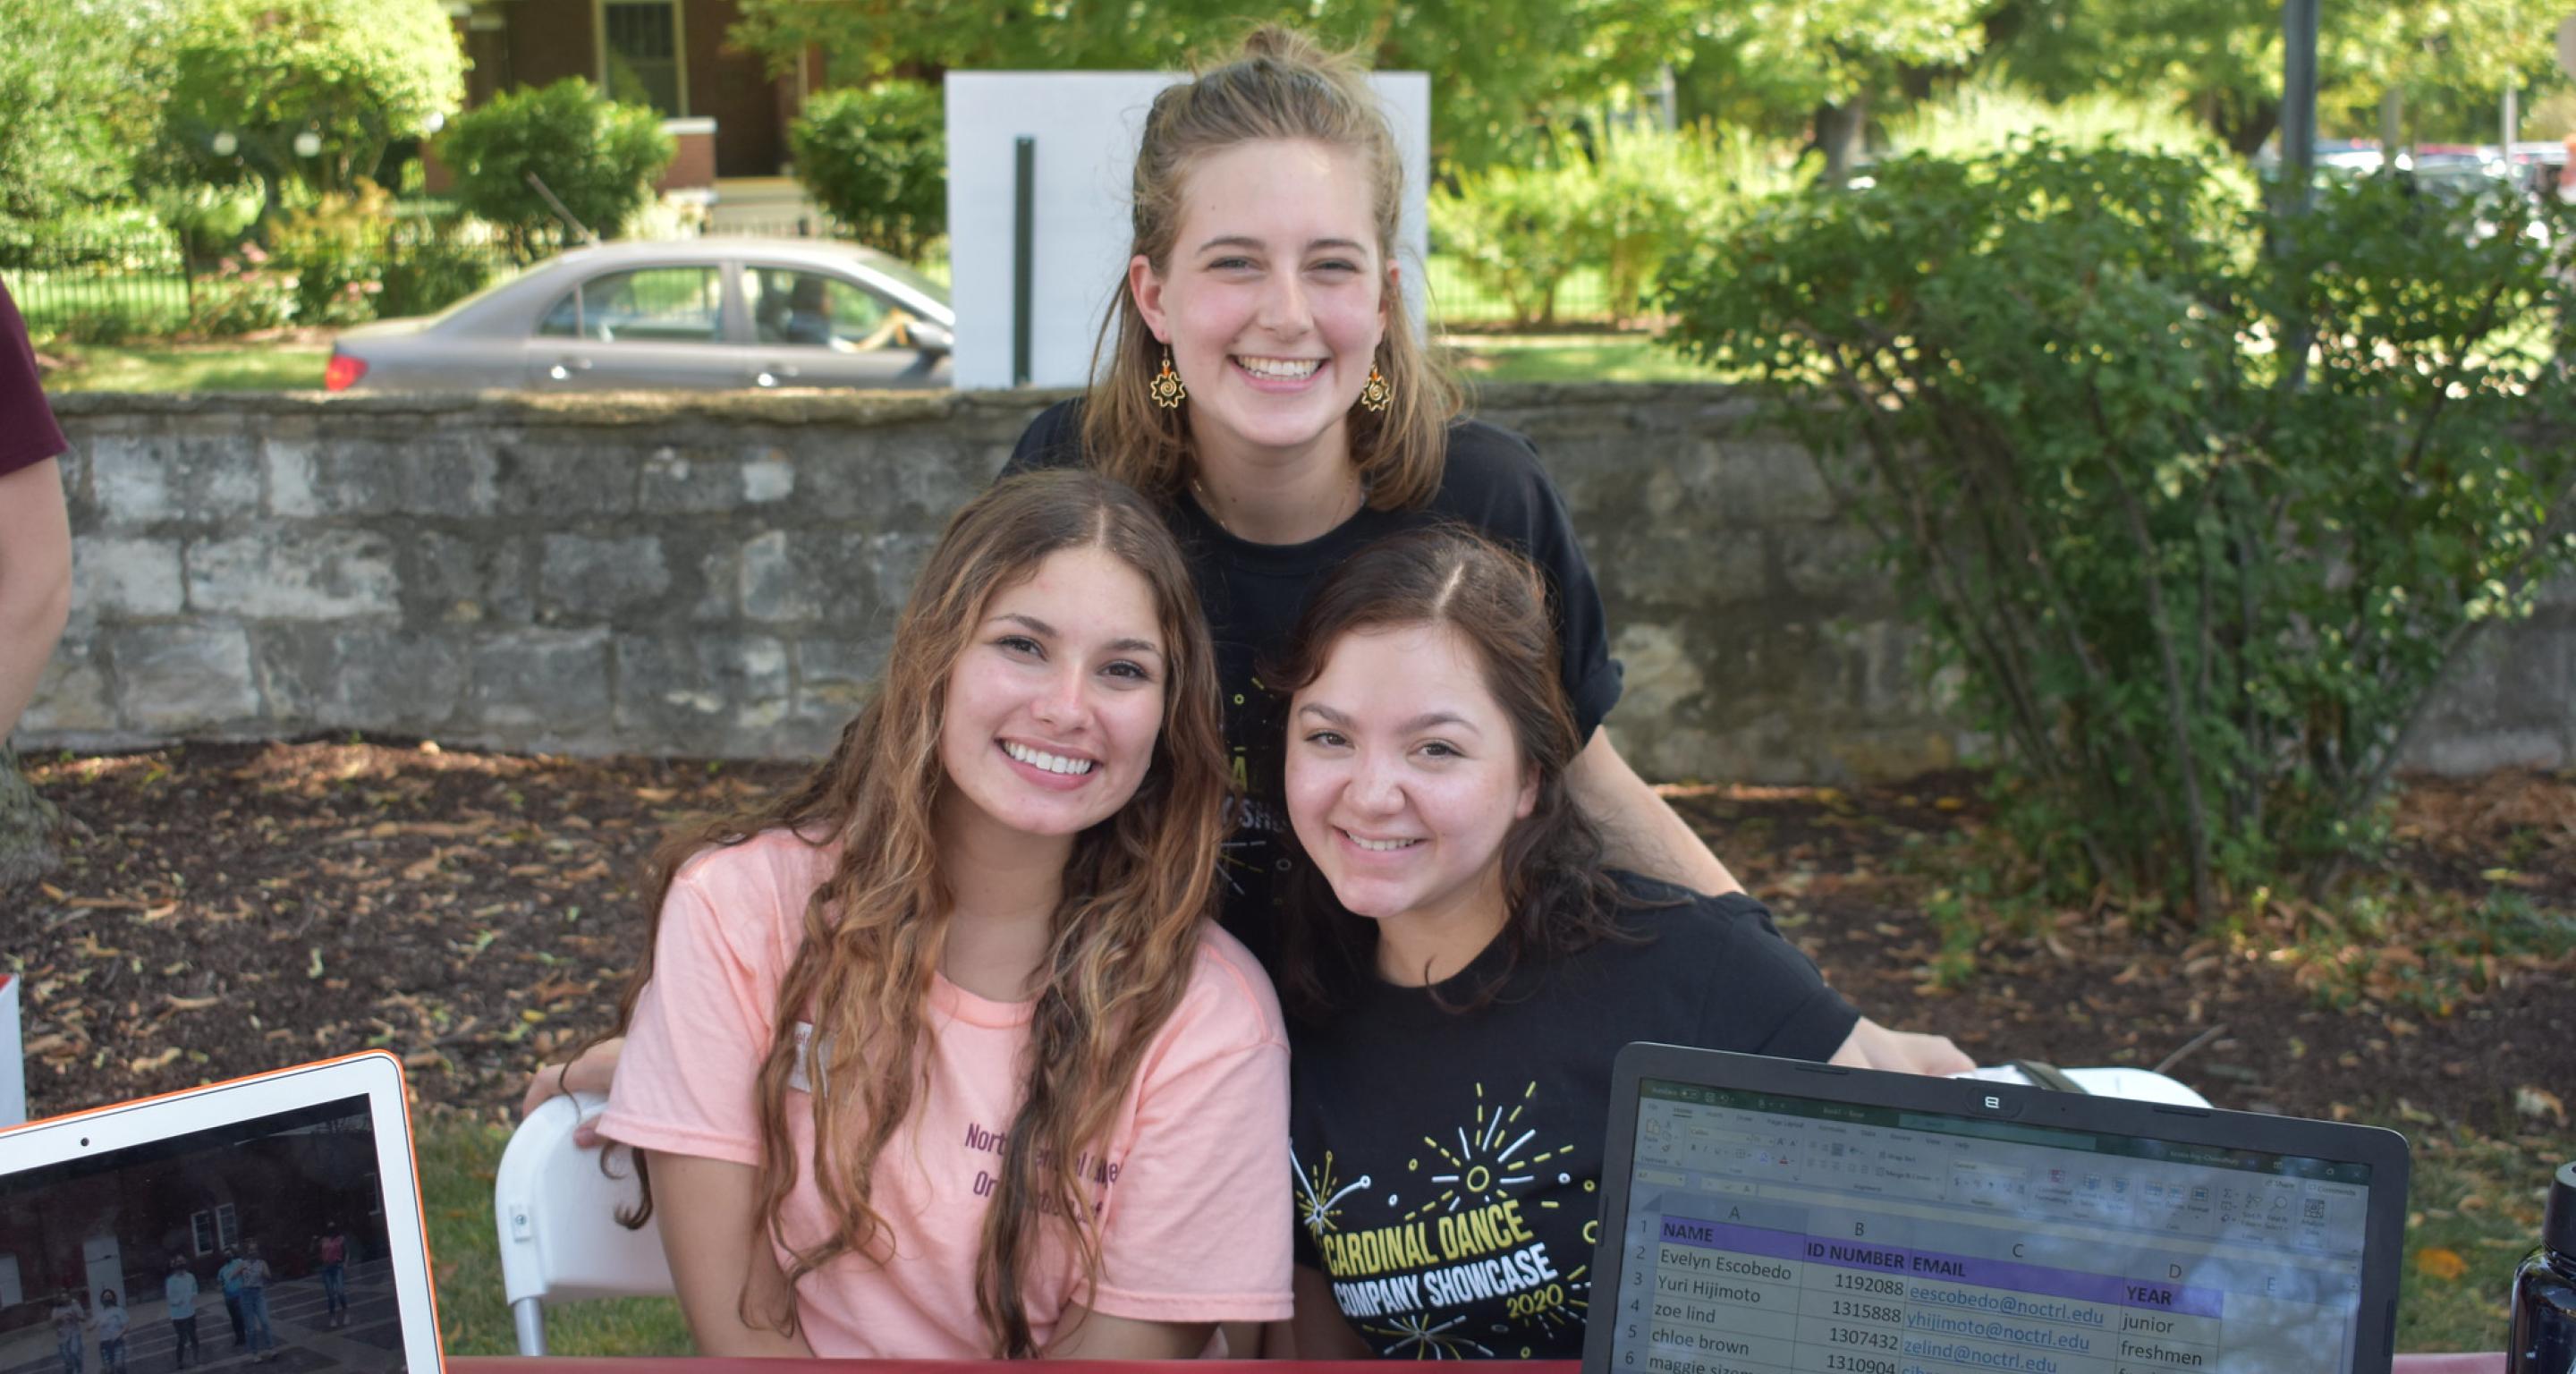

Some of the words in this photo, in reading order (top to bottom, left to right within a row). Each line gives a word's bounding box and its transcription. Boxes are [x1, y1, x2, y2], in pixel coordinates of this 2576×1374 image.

[964, 1123, 1007, 1156] Nort
[1322, 1222, 1440, 1278] CARDINAL
[1438, 1200, 1534, 1262] DANCE
[1640, 1220, 1648, 1233] 1
[1663, 1222, 1714, 1243] NAME
[1807, 1243, 1826, 1259] ID
[1829, 1245, 1905, 1270] NUMBER
[1912, 1256, 1966, 1278] EMAIL
[2126, 1285, 2173, 1306] YEAR
[1729, 1206, 1741, 1221] A
[1854, 1222, 1865, 1237] B
[2012, 1243, 2024, 1259] C
[2168, 1263, 2182, 1279] D
[2267, 1276, 2276, 1291] E
[1332, 1275, 1425, 1318] COMPANY
[1424, 1243, 1559, 1309] SHOWCASE
[1506, 1284, 1564, 1319] 2020
[1636, 1245, 1647, 1260] 2
[1660, 1249, 1711, 1270] Evelyn
[1716, 1257, 1792, 1281] Escobedo
[1835, 1274, 1905, 1296] 1192088
[1910, 1285, 2105, 1326] eescobedo@noctrl.edu
[2122, 1313, 2174, 1334] junior
[1627, 1325, 1638, 1339] 5
[1651, 1328, 1695, 1348] chloe
[1699, 1333, 1750, 1356] brown
[1826, 1354, 1896, 1374] 1310904
[1630, 1299, 1640, 1313] 4
[1654, 1304, 1682, 1319] zoe
[1686, 1303, 1716, 1324] lind
[1829, 1327, 1899, 1351] 1307432
[1902, 1338, 2058, 1374] zelind@noctrl.edu
[1633, 1271, 1644, 1286] 3
[1658, 1275, 1689, 1293] Yuri
[1692, 1279, 1761, 1304] Hijimoto
[1832, 1301, 1902, 1324] 1315888
[1906, 1311, 2090, 1353] yhijimoto@noctrl.edu
[2121, 1340, 2203, 1367] freshmen
[1624, 1351, 1635, 1366] 6
[1649, 1355, 1706, 1374] maggie
